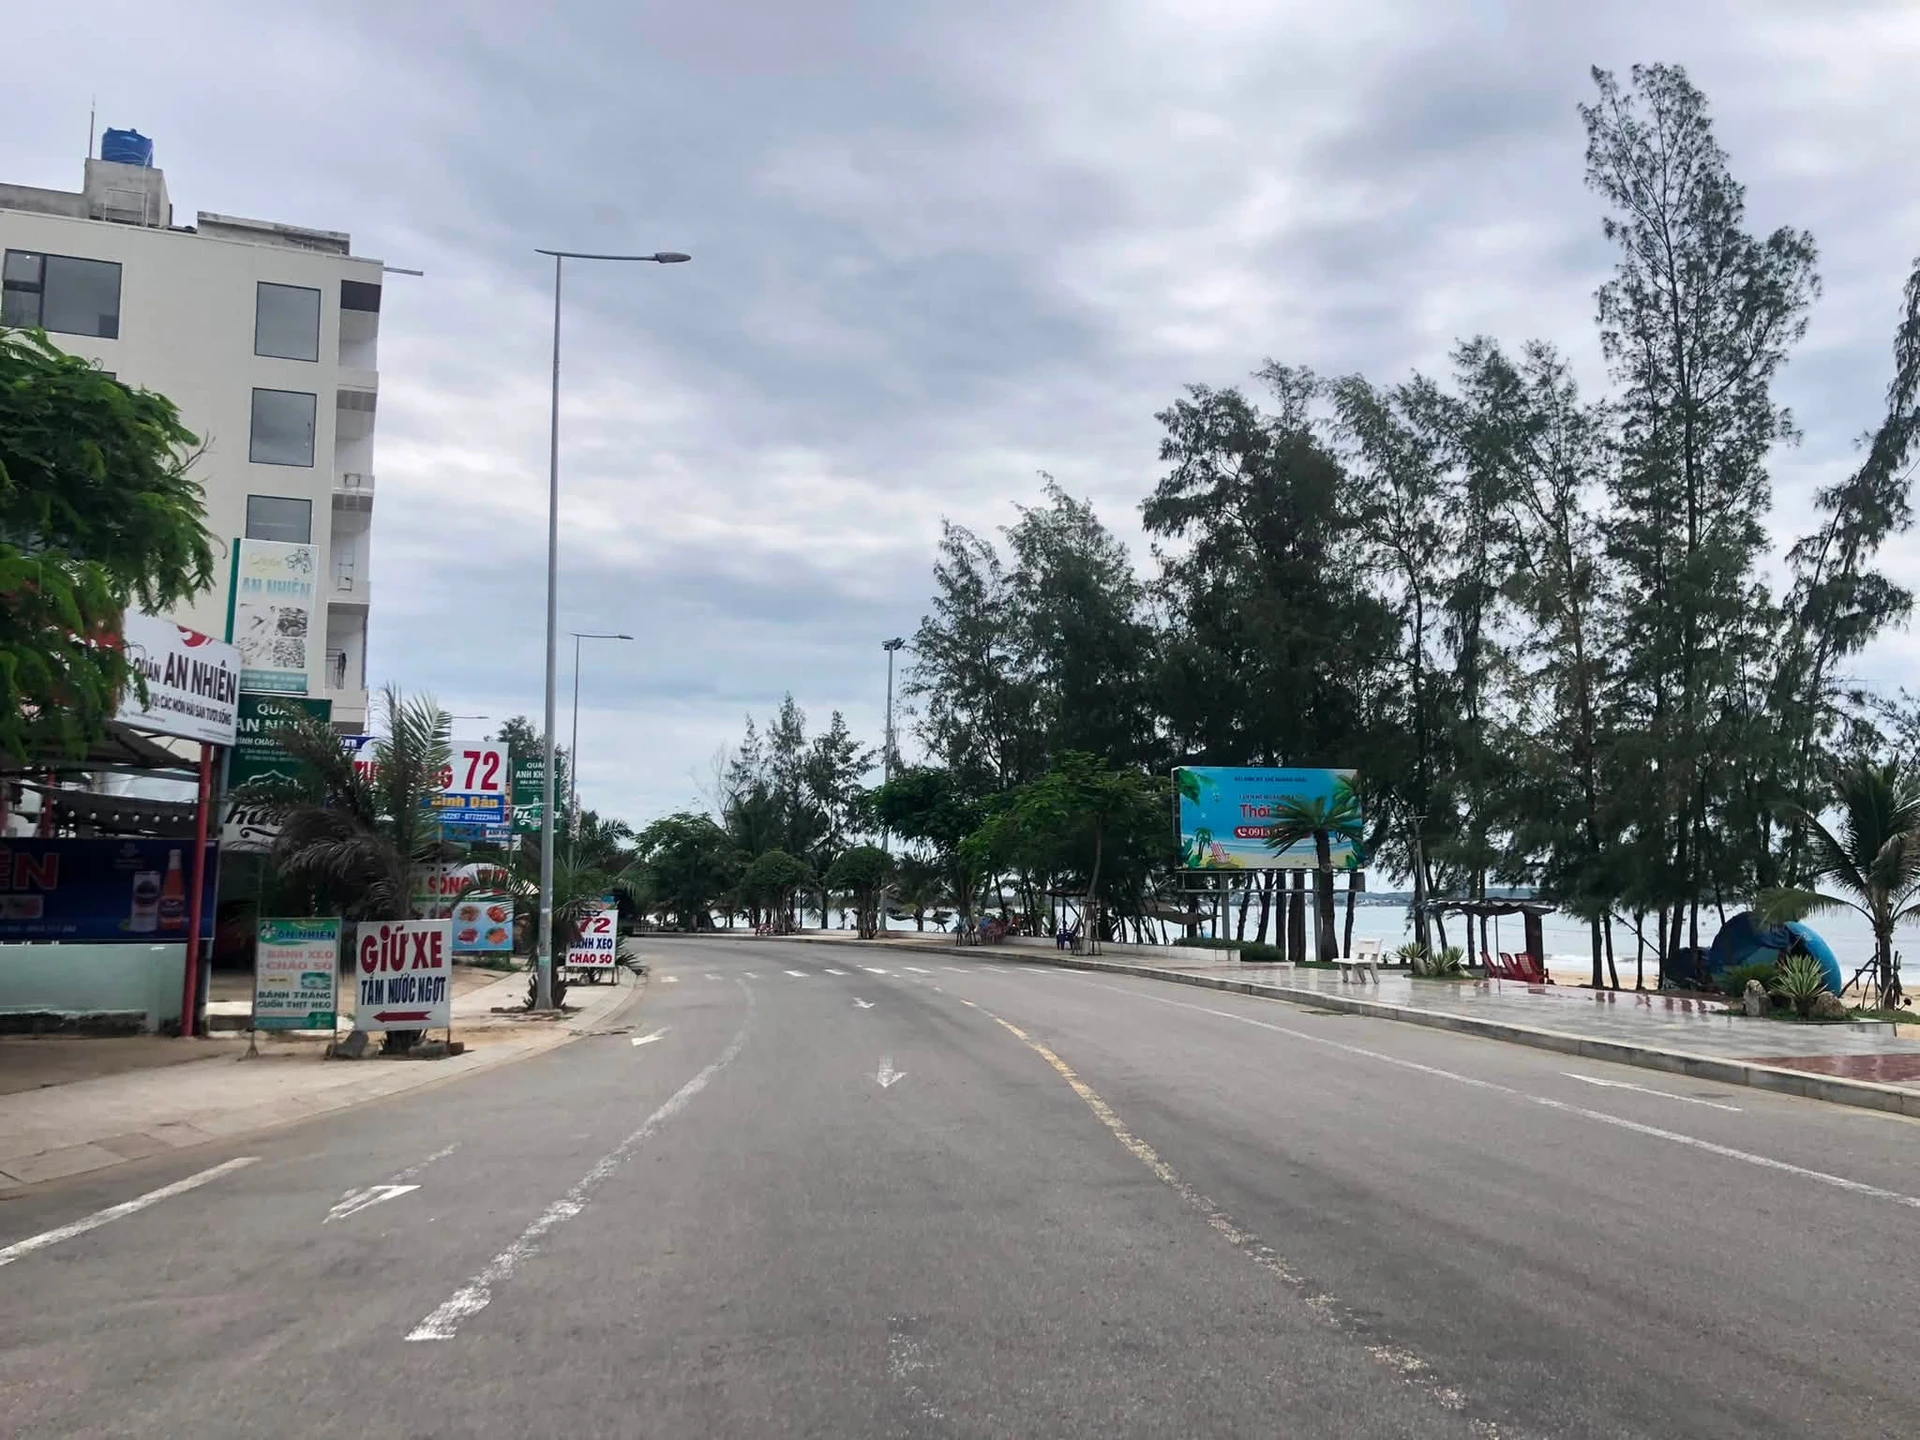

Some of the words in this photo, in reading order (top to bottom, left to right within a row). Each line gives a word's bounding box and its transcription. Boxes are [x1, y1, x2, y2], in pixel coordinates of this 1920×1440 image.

[163, 652, 189, 690] AN
[191, 660, 236, 705] NHIÊN
[463, 750, 501, 791] 72
[516, 770, 532, 778] ANH
[578, 917, 611, 933] 72
[411, 931, 442, 969] XE
[388, 973, 416, 1004] NƯỚC
[418, 976, 446, 1004] NGỌT
